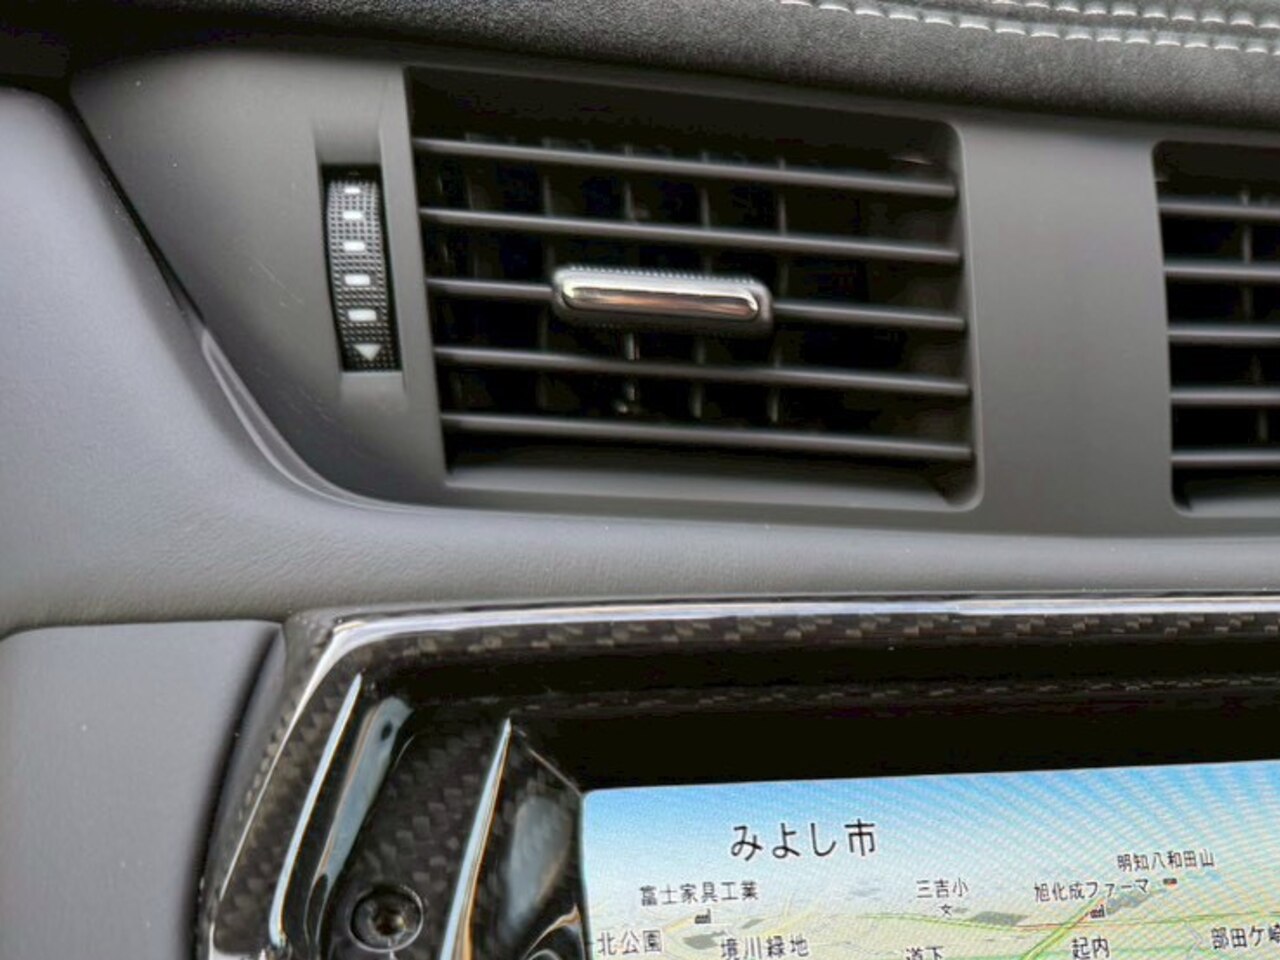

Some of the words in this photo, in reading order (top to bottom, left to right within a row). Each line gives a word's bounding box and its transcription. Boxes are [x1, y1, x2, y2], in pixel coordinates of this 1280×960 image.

[730, 818, 876, 861] みよし市
[640, 881, 759, 906] 富士家具工業
[916, 878, 969, 899] 三吉小
[1034, 878, 1149, 903] 旭化成ファーマ
[597, 930, 662, 957] 北公園
[1071, 937, 1110, 960] 起内
